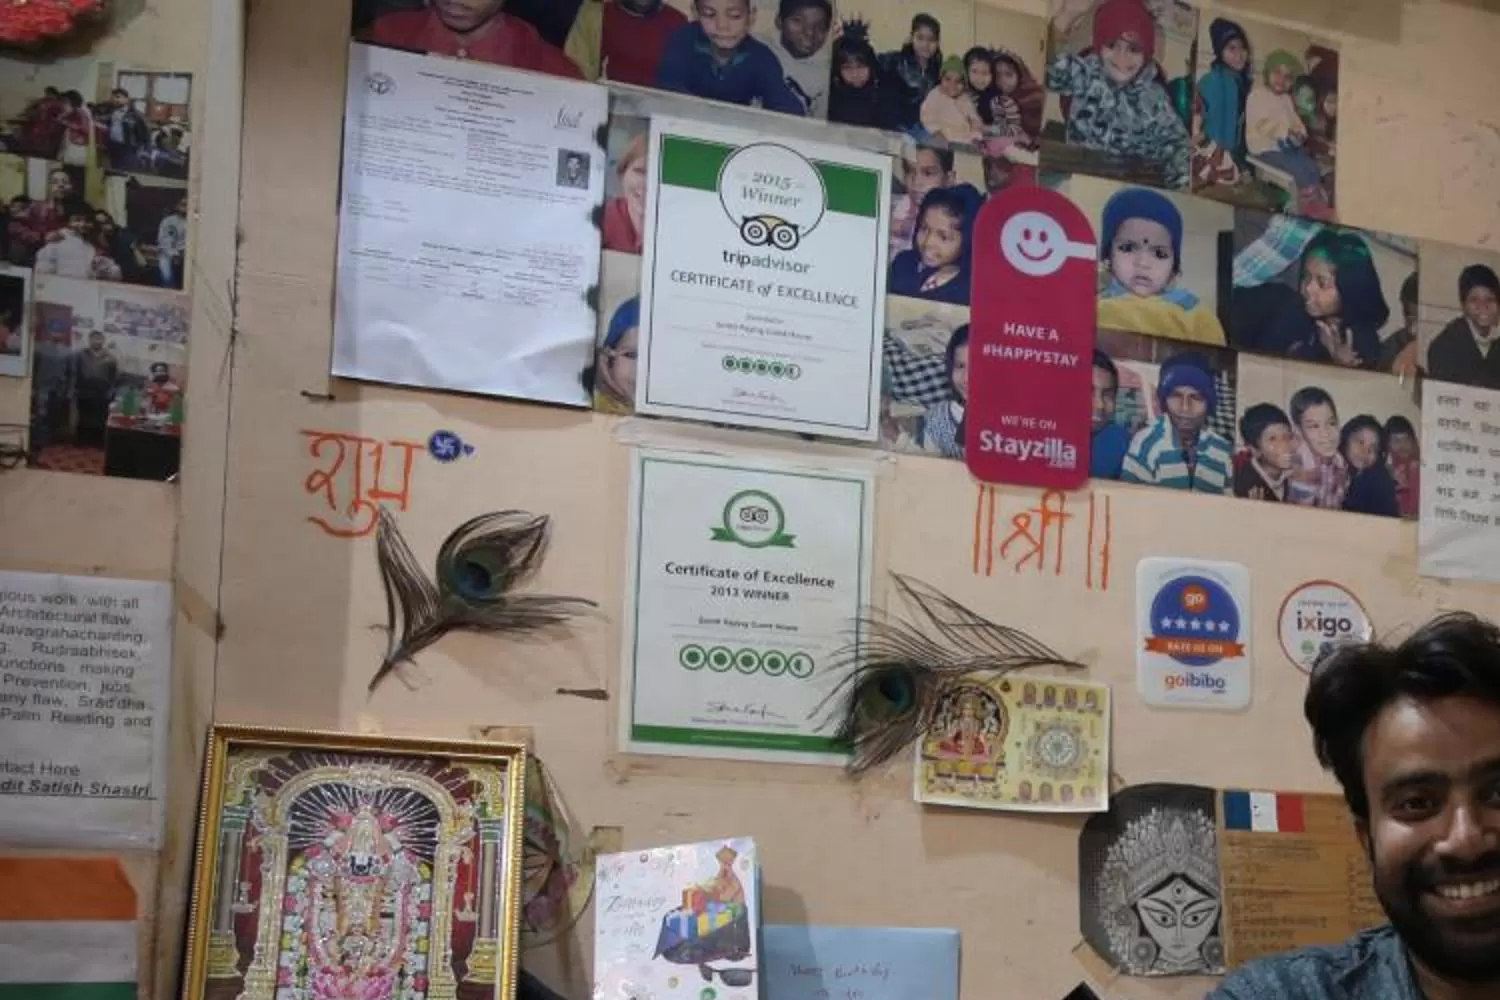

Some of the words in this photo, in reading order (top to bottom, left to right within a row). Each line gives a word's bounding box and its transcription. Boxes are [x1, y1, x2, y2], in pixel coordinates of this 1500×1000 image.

[751, 171, 794, 190] 2015
[741, 185, 803, 209] Winner
[722, 248, 812, 274] tripadvisor
[670, 268, 753, 293] CERTIFICATE
[757, 281, 773, 297] of
[777, 284, 860, 308] EXCELLENCE
[1003, 321, 1046, 340] HAVE
[1047, 328, 1060, 342] A
[981, 343, 1079, 367] #HAPPYSTAY
[1038, 418, 1057, 432] ON
[979, 429, 1078, 462] Stayzilla
[300, 429, 427, 539] शुभ
[664, 561, 739, 581] Certificate
[743, 568, 759, 582] of
[762, 569, 836, 590] Excellence
[710, 585, 740, 599] 2013
[742, 587, 791, 602] WINNER
[1297, 610, 1353, 638] ixigo
[1164, 669, 1227, 691] goibibo
[50, 709, 115, 729] Reading
[122, 714, 152, 728] and
[28, 780, 83, 795] Satish
[89, 781, 150, 797] Shastri
